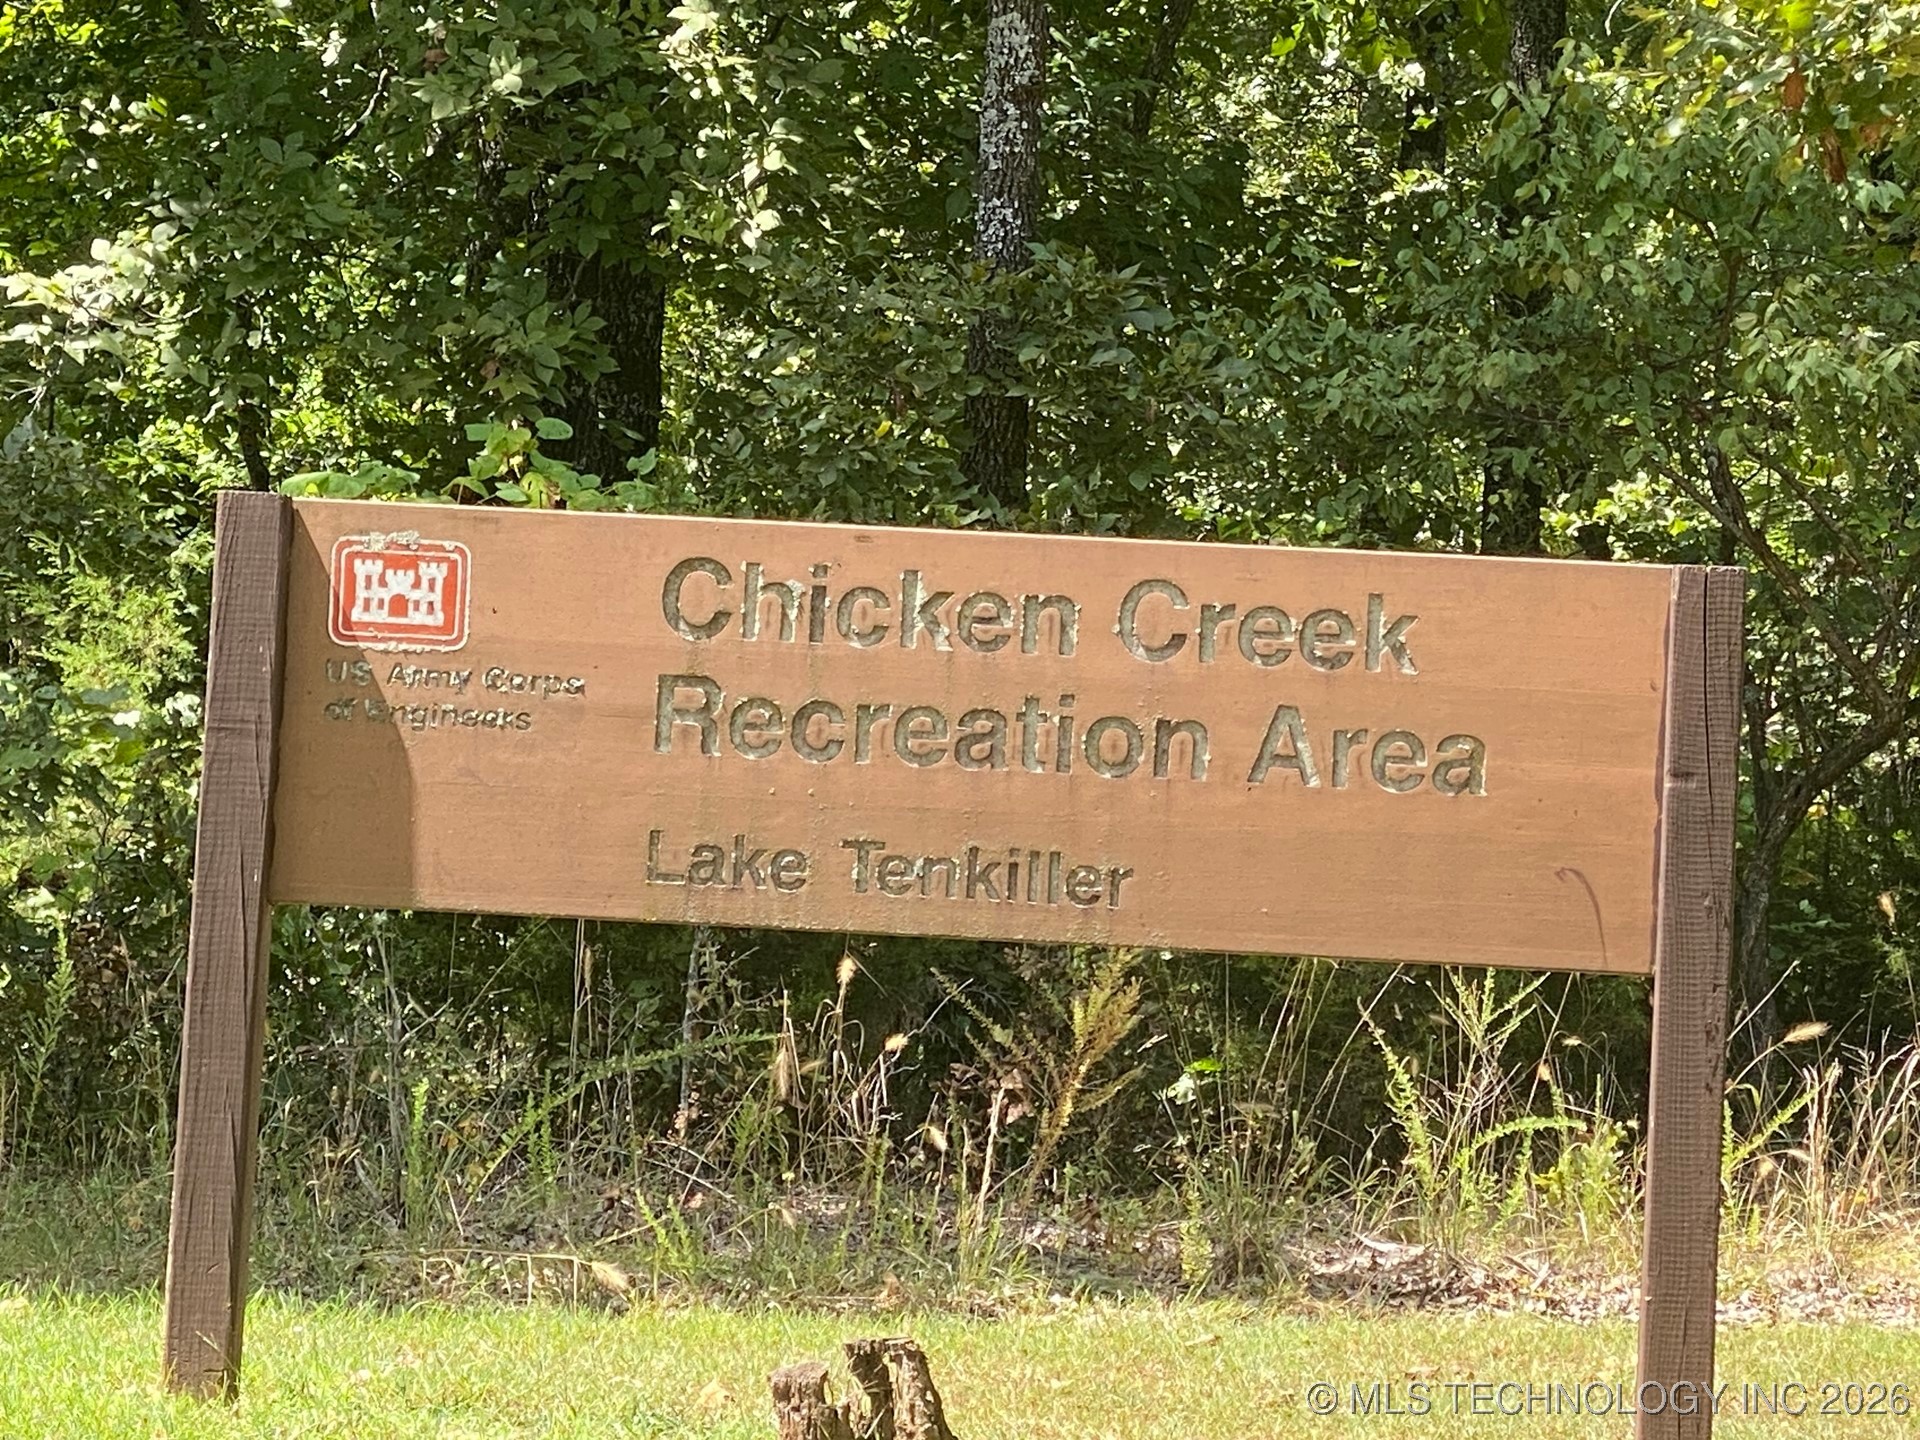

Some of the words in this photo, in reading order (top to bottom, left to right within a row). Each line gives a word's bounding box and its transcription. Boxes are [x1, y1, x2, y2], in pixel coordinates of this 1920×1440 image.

[662, 556, 1081, 656] Chicken
[1115, 578, 1419, 675] Creek
[323, 698, 358, 721] of
[364, 698, 533, 732] Engineers
[325, 657, 372, 687] US
[387, 662, 473, 695] Army
[482, 666, 586, 699] Corps
[654, 673, 1212, 782] Recreation
[1247, 704, 1488, 797] Area
[645, 828, 810, 894] Lake
[839, 837, 1135, 909] Tenkiller
